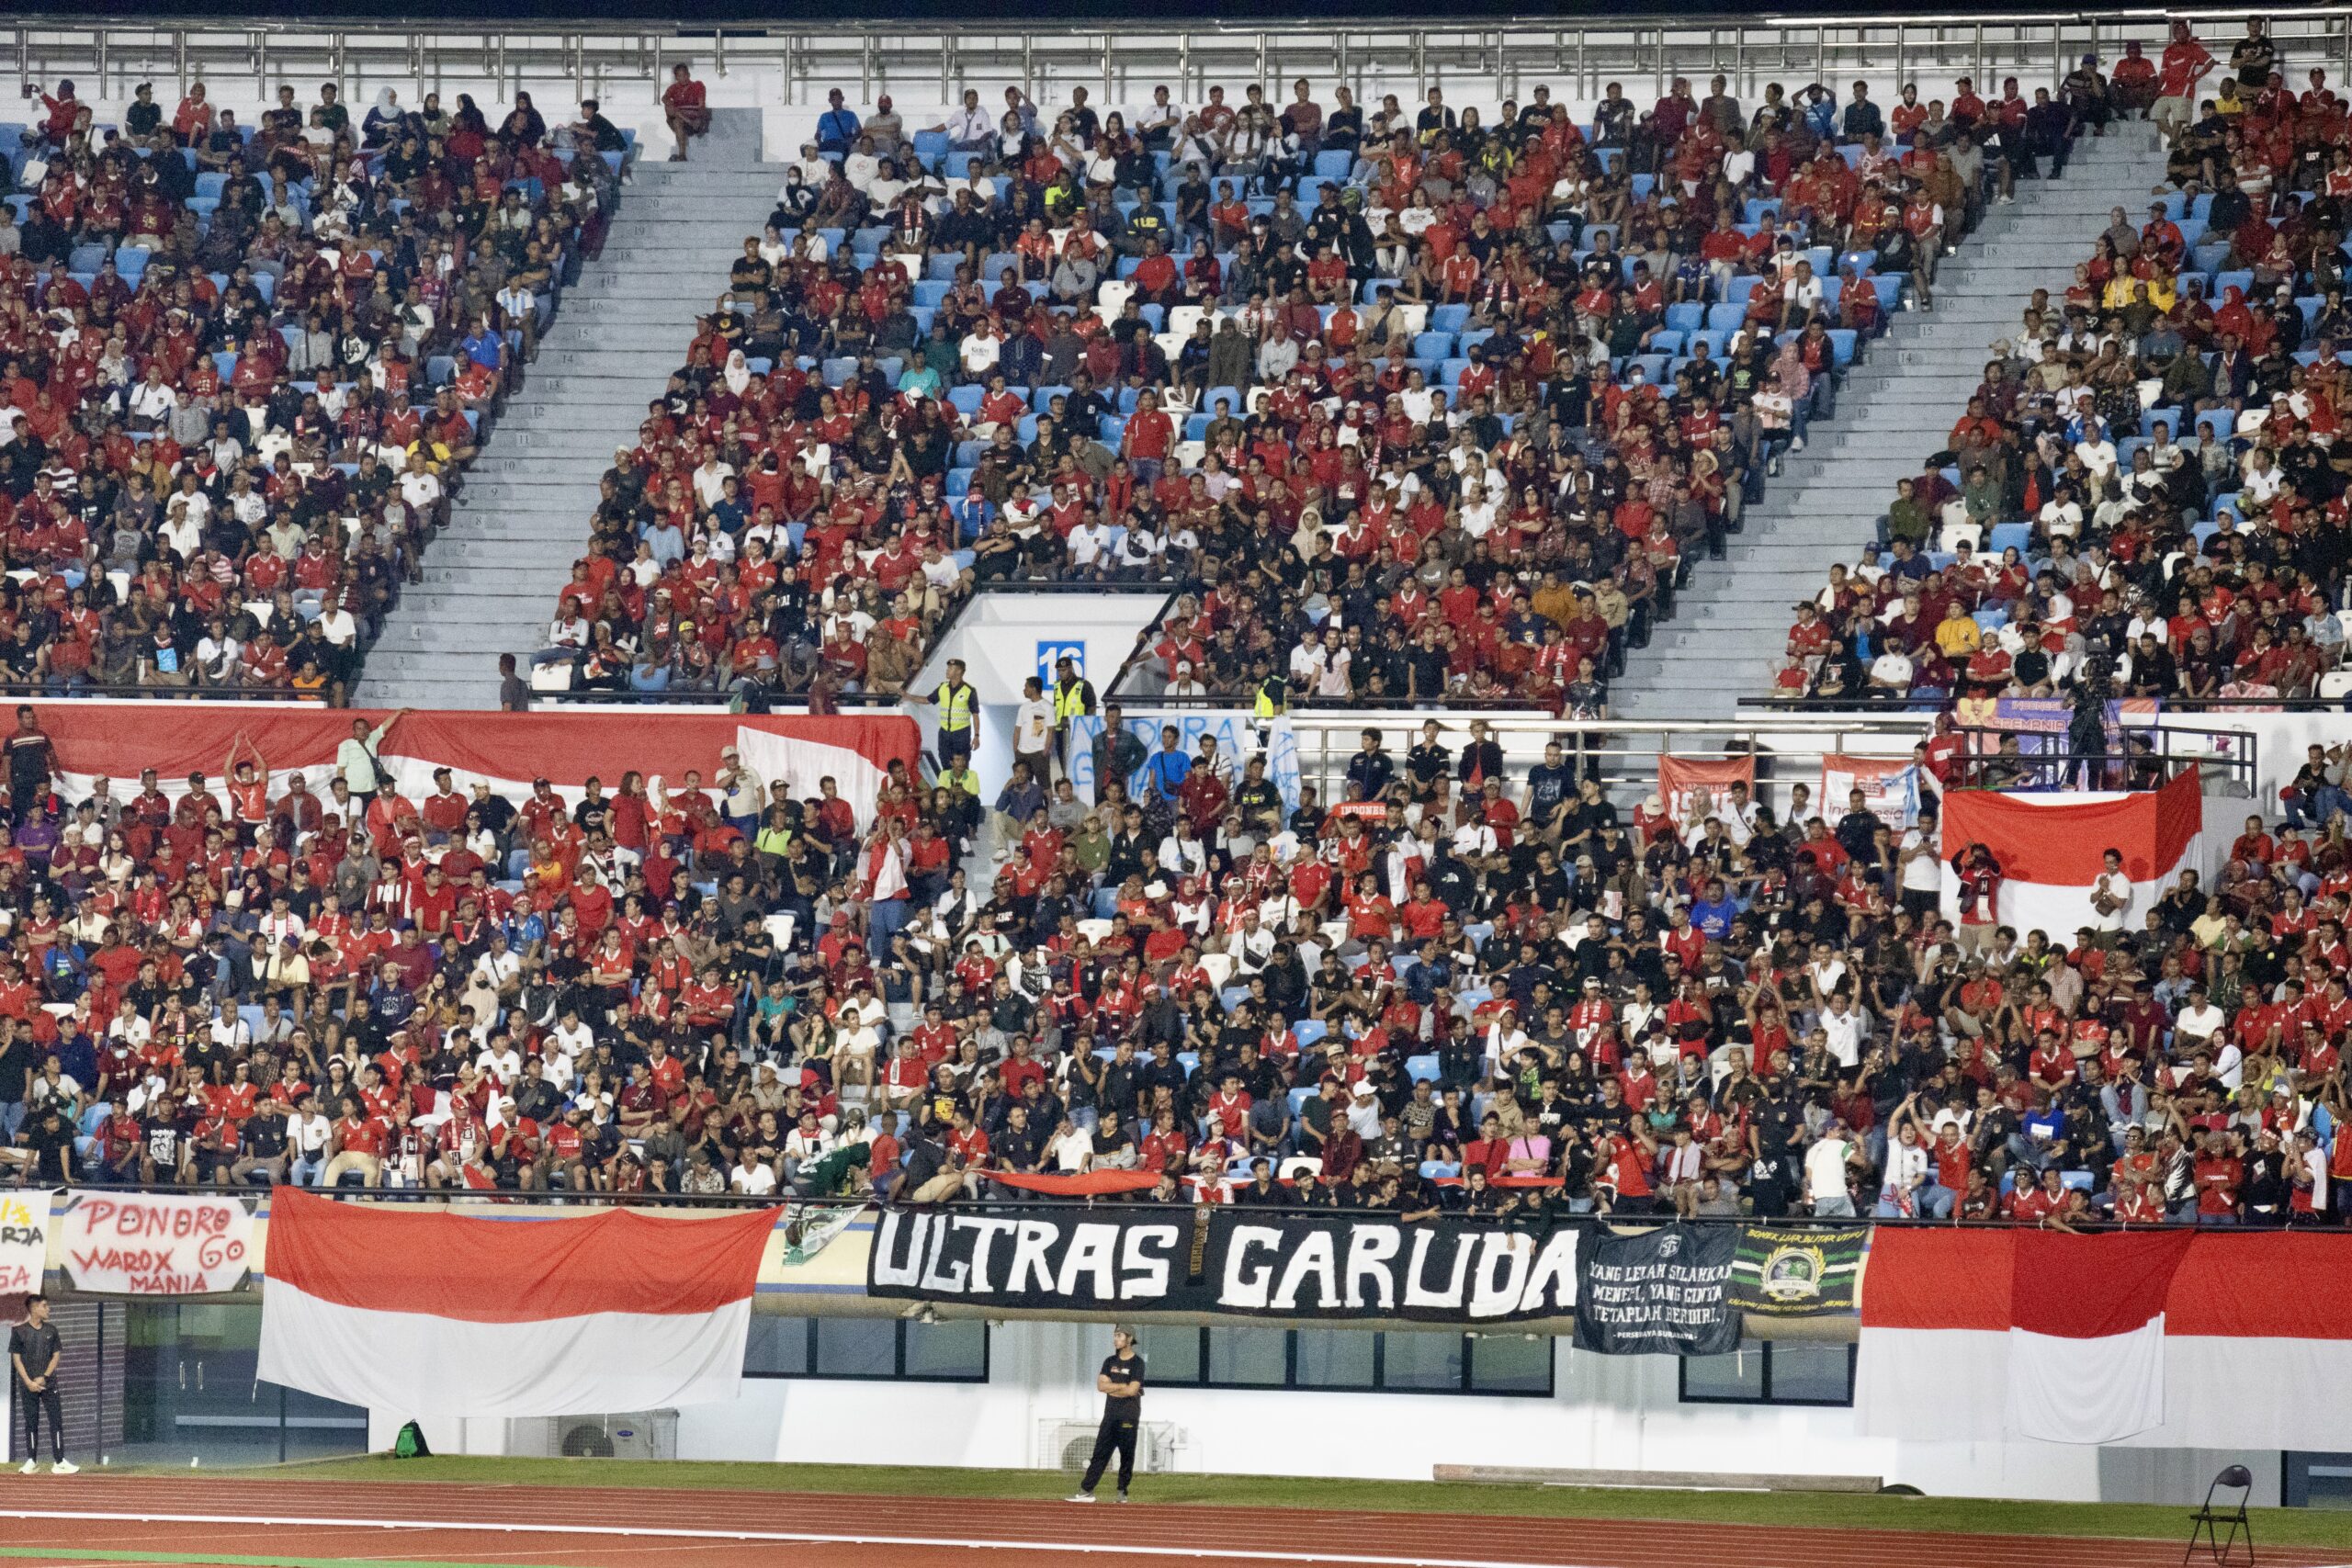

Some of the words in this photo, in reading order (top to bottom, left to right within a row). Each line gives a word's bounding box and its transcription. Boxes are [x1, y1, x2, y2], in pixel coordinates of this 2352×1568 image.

[1039, 647, 1083, 685] 16
[198, 1234, 244, 1270] GO
[874, 1213, 1180, 1300] ULTRAS
[1217, 1224, 1580, 1318] GARUDA
[1590, 1261, 1622, 1281] YANG
[1624, 1264, 1667, 1281] LELAH
[129, 1271, 208, 1293] MANIA
[1649, 1284, 1680, 1301] YANG
[1684, 1285, 1722, 1303] CINTA
[1593, 1304, 1662, 1323] TETAPLAH
